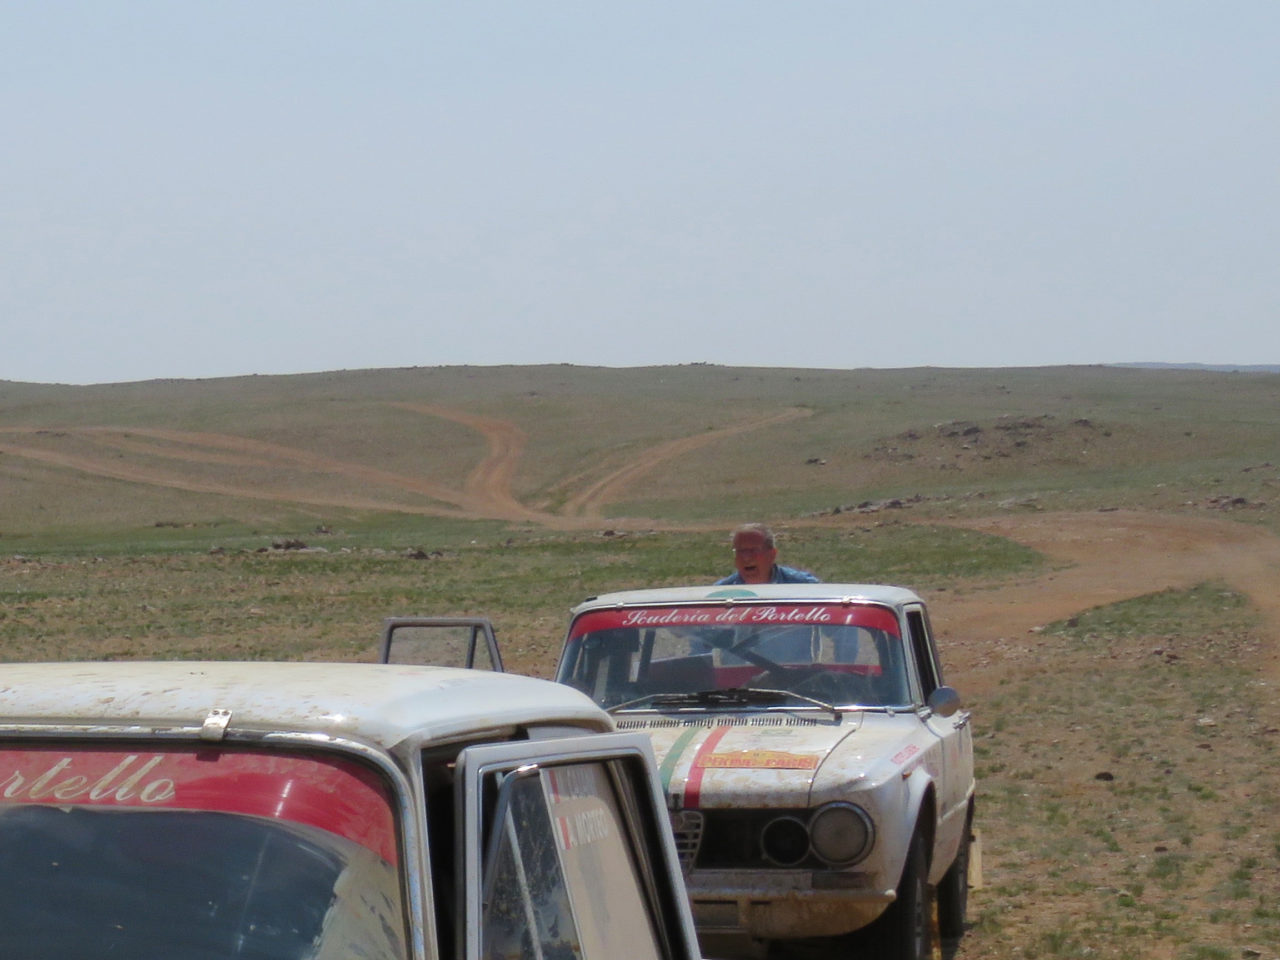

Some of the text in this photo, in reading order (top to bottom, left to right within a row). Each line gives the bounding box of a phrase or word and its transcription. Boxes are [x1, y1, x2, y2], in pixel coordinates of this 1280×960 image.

[622, 606, 831, 626] Scuderia del Portello
